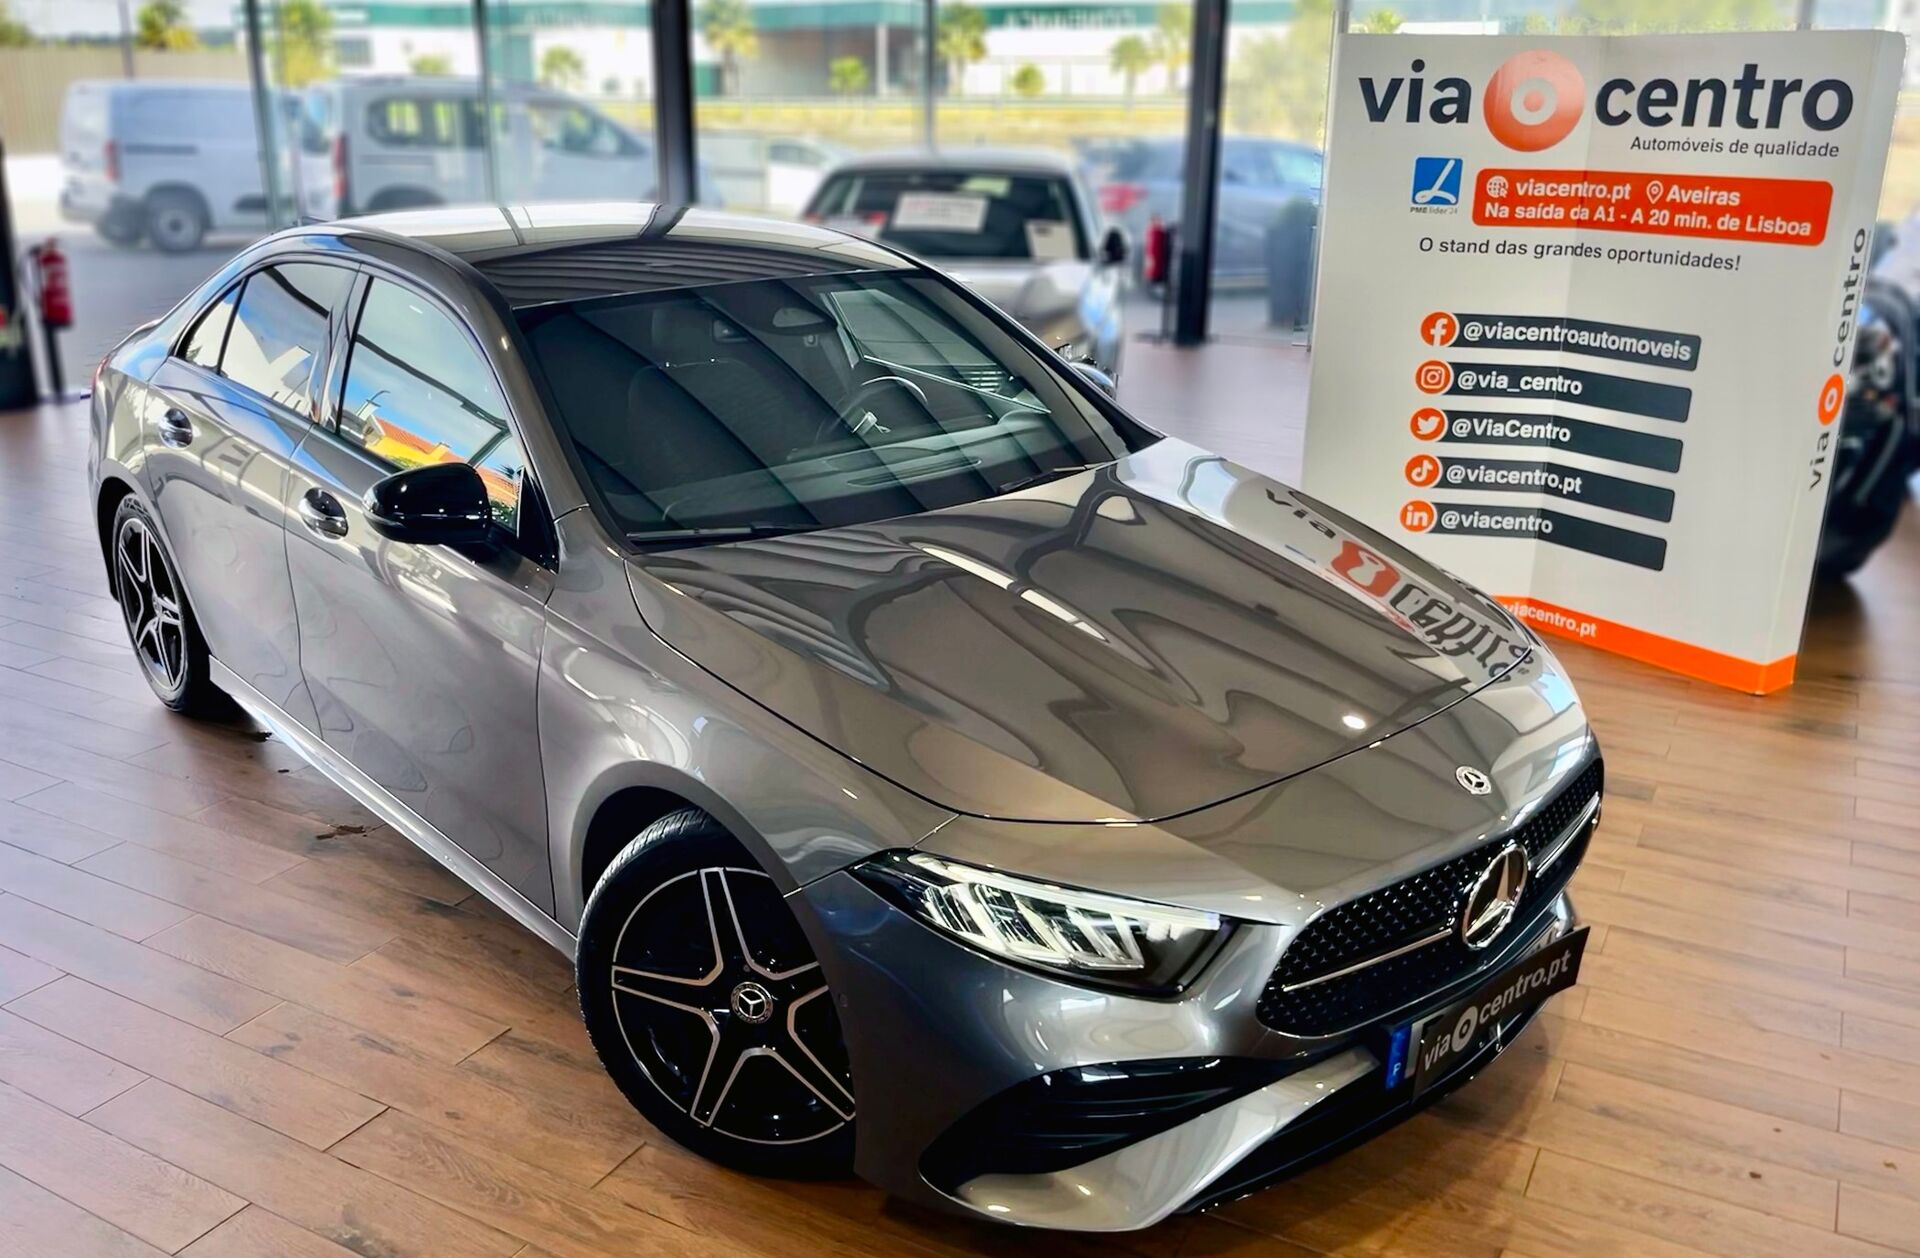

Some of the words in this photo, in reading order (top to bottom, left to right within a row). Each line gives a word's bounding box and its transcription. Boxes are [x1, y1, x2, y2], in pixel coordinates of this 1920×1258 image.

[1358, 59, 1472, 124] via
[1595, 63, 1854, 132] centro
[1630, 136, 1724, 154] Automóveis
[1728, 139, 1749, 154] de
[1753, 141, 1840, 158] qualidade
[1516, 179, 1631, 202] viacentro.pt
[1666, 184, 1741, 207] Aveiras
[1485, 202, 1509, 218] Na
[1514, 203, 1564, 220] saída
[1569, 205, 1590, 221] da
[1593, 206, 1615, 223] A1
[1630, 208, 1644, 224] A
[1648, 209, 1670, 226] 20
[1673, 211, 1713, 230] min.
[1716, 213, 1740, 231] de
[1745, 215, 1812, 236] Lisboa
[1419, 237, 1434, 252] O
[1439, 239, 1490, 254] stand
[1495, 240, 1528, 256] das
[1533, 243, 1602, 260] grandes
[1607, 248, 1742, 271] oportunidades!
[1463, 321, 1692, 361] @viacentroautomoveis
[1809, 431, 1830, 491] via
[1833, 228, 1866, 367] centro
[1457, 370, 1583, 396] @via_centro
[1452, 418, 1571, 442] @ViaCentro
[1446, 465, 1582, 494] @viacentro.pt
[1440, 510, 1553, 534] @viacentro
[1425, 1034, 1451, 1071] via
[1479, 949, 1571, 1026] centro.pt
